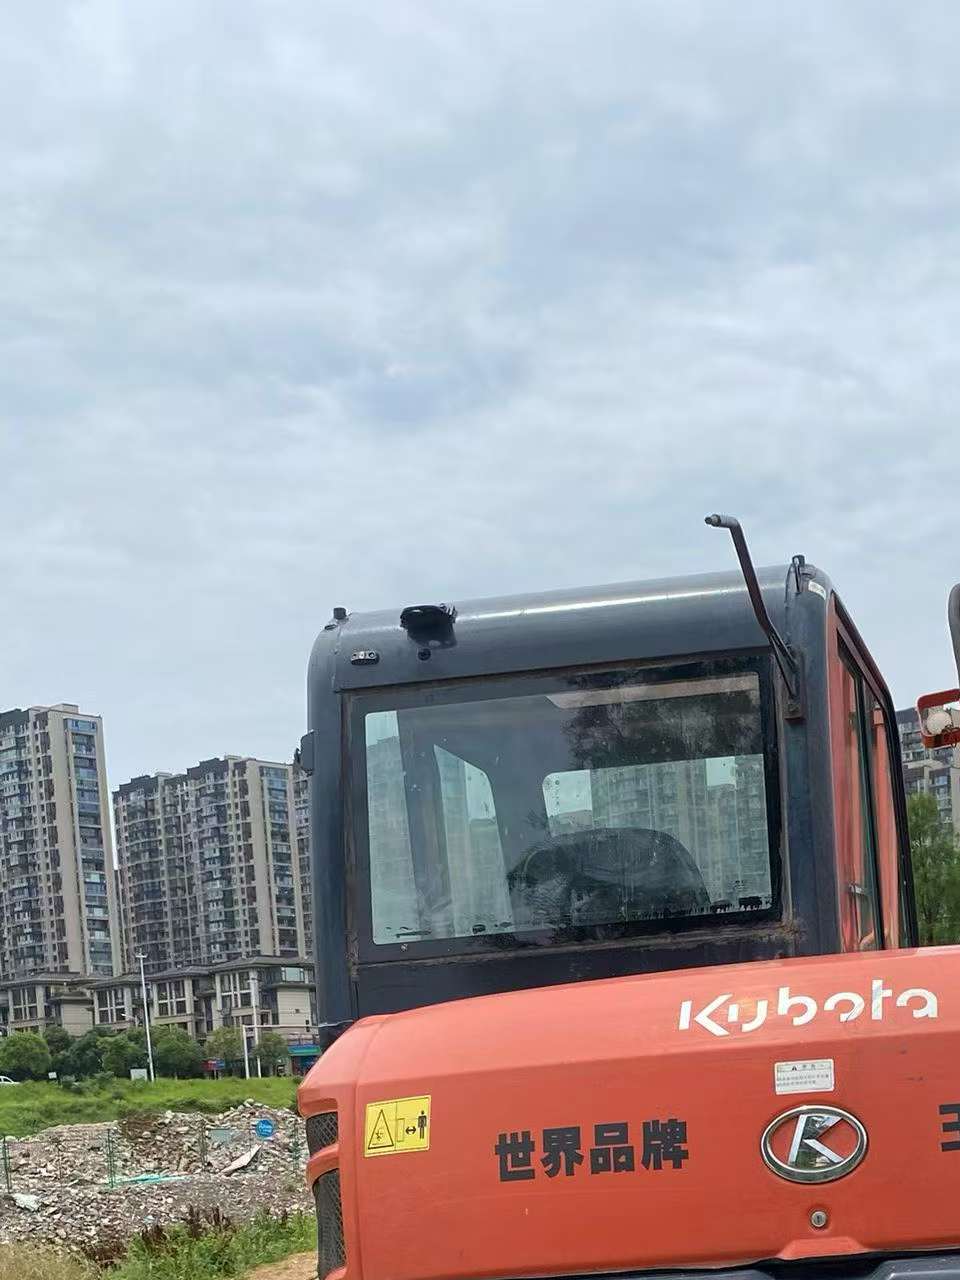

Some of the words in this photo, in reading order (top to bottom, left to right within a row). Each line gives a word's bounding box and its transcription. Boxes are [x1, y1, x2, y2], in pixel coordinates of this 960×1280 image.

[678, 979, 938, 1037] Kubota
[495, 1118, 689, 1182] 世界品牌
